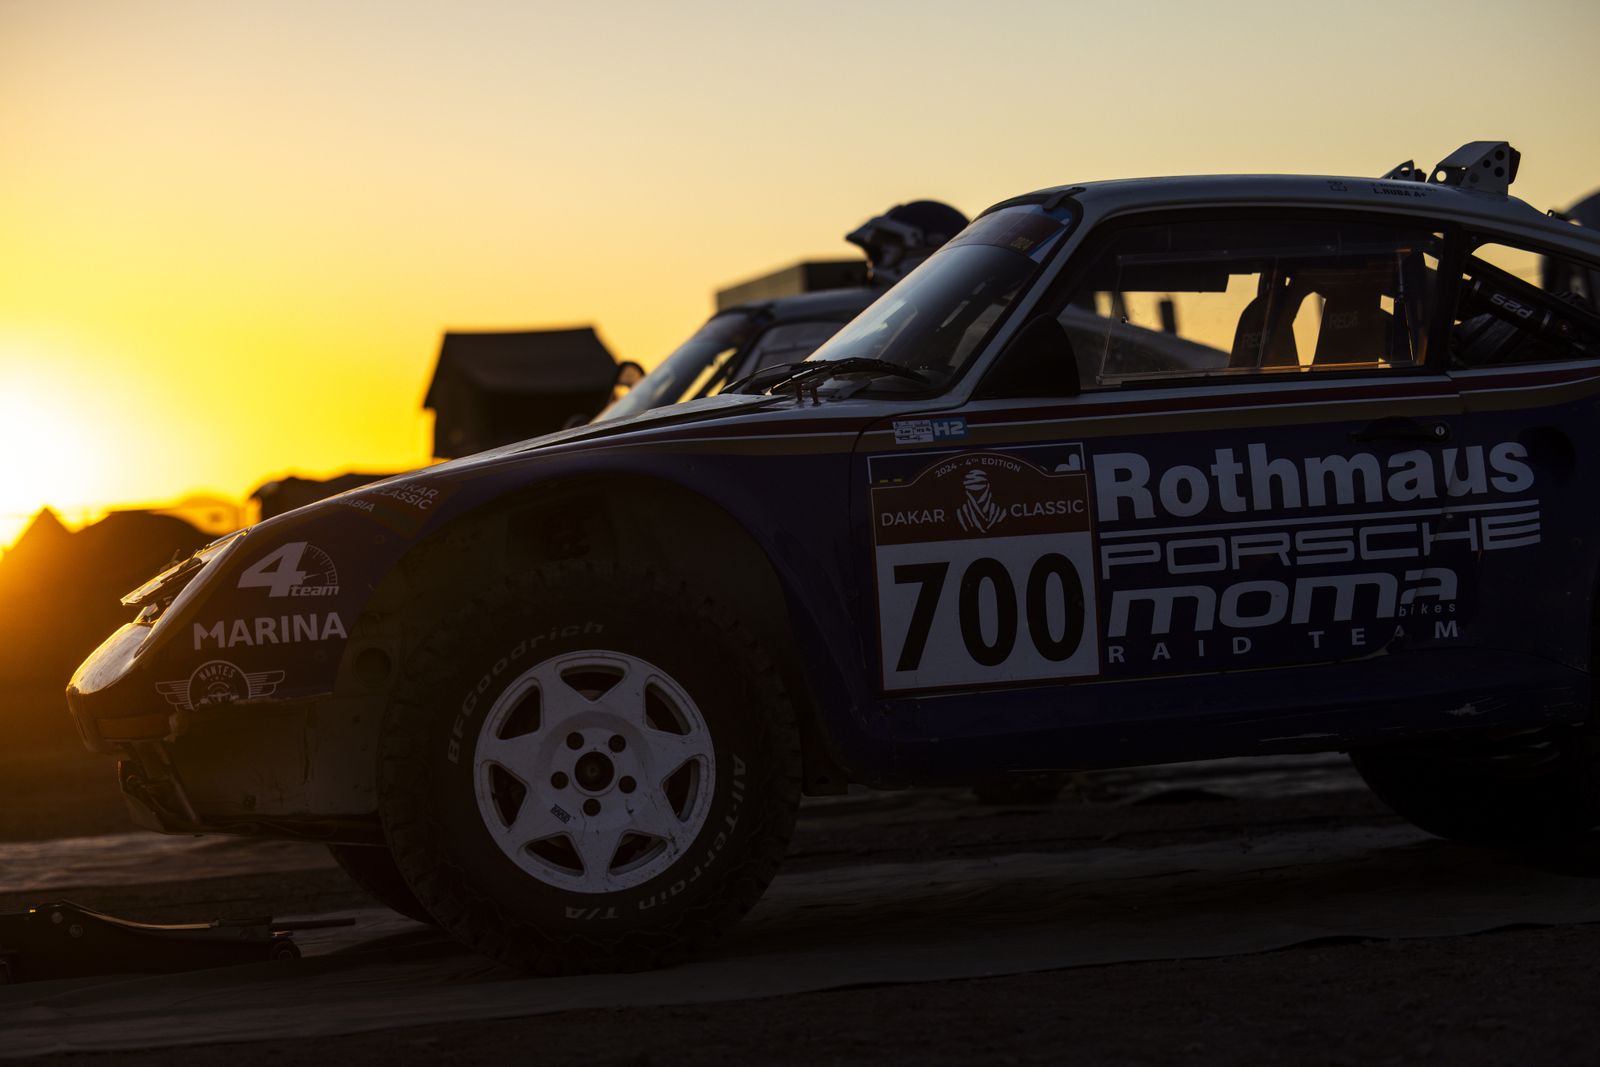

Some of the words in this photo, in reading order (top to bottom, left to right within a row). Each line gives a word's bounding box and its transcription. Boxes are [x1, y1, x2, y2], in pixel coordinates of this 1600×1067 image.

[933, 421, 965, 436] H2
[936, 464, 958, 477] 2024
[981, 457, 1021, 473] EDITION
[1093, 441, 1535, 522] Rothmaus
[881, 508, 945, 527] DAKAR
[1010, 499, 1084, 518] CLASSIC
[1101, 510, 1541, 580] PORSCHE
[237, 541, 307, 597] 4
[290, 584, 339, 597] team
[893, 553, 1084, 671] 700
[1108, 567, 1458, 638] moma
[1399, 602, 1456, 617] bikes
[193, 612, 348, 650] MARINA
[1108, 636, 1253, 664] RAID
[1308, 620, 1458, 649] TEAM
